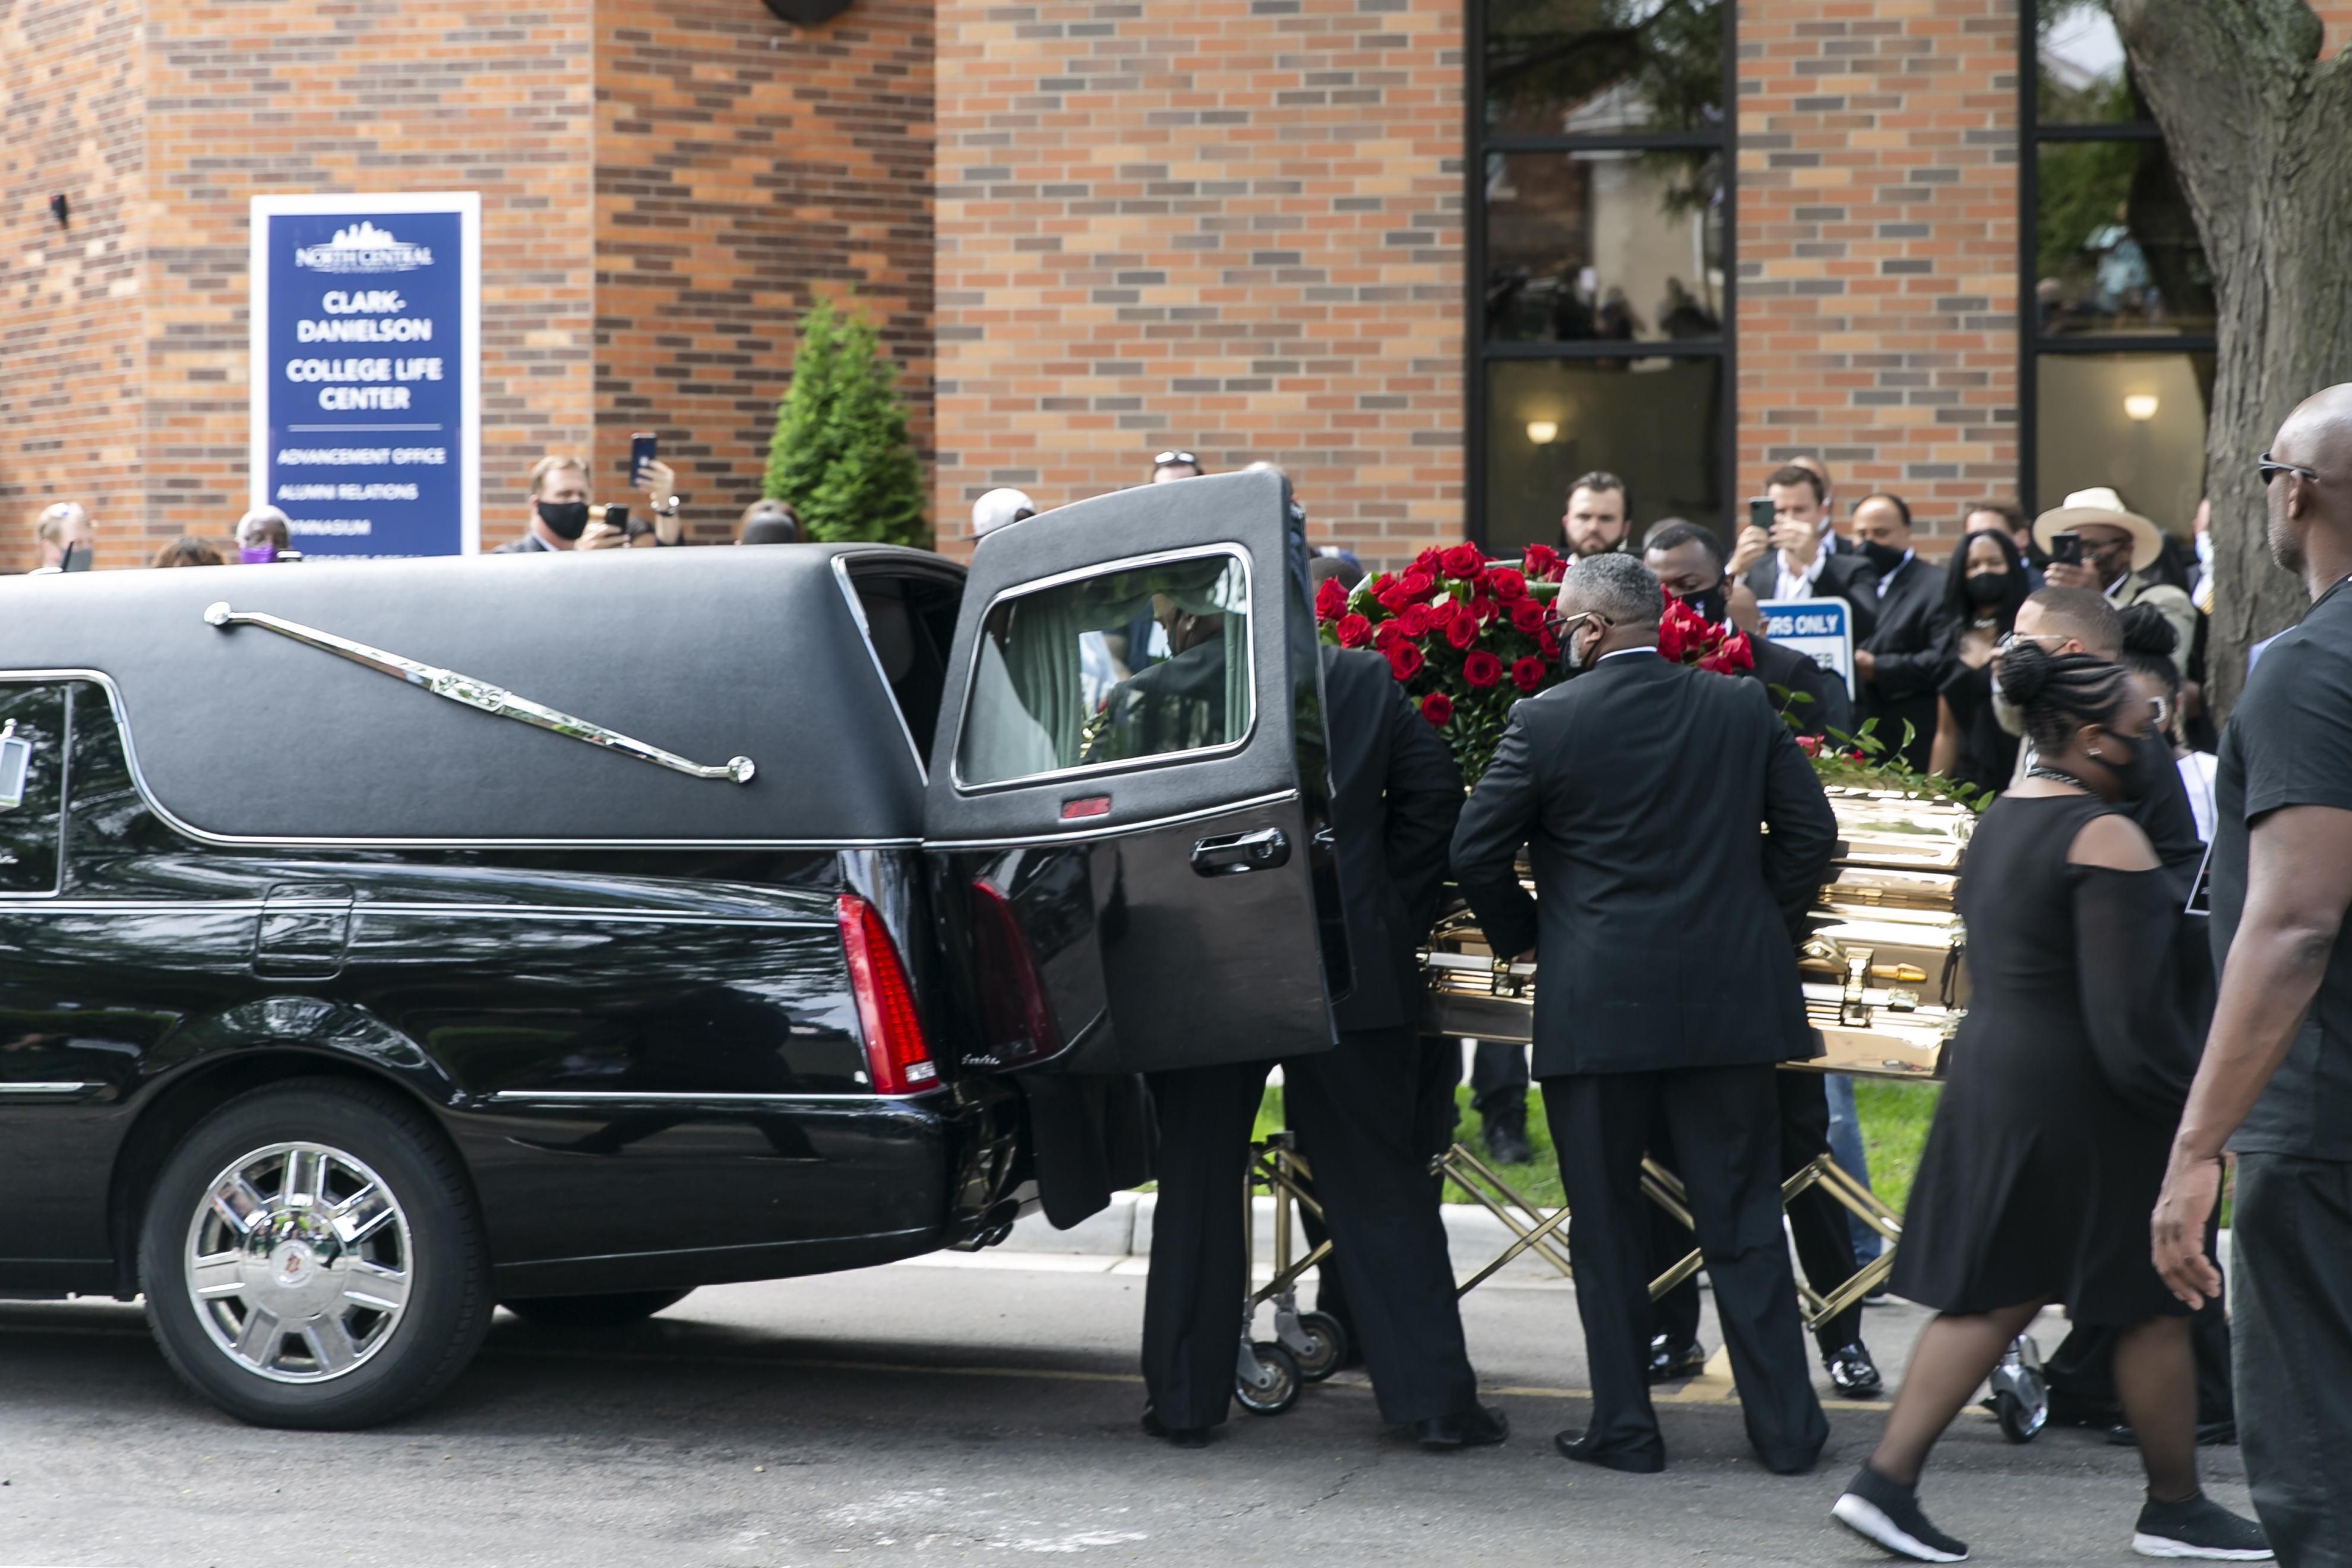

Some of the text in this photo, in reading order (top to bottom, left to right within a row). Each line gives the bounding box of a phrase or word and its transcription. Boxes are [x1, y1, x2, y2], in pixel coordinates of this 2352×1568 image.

[295, 246, 435, 267] NORTH CENTRAL
[323, 290, 407, 314] CLARK-
[298, 318, 432, 342] DANIELSON
[286, 358, 444, 382] COLLEGE LIFE
[318, 387, 410, 410] CENTER
[277, 447, 446, 465] ADVANCEMENT OFFICE
[277, 483, 419, 500] ALUMNI RELATIONS
[289, 519, 371, 536] YMNASIUM
[1795, 613, 1839, 634] ONLY
